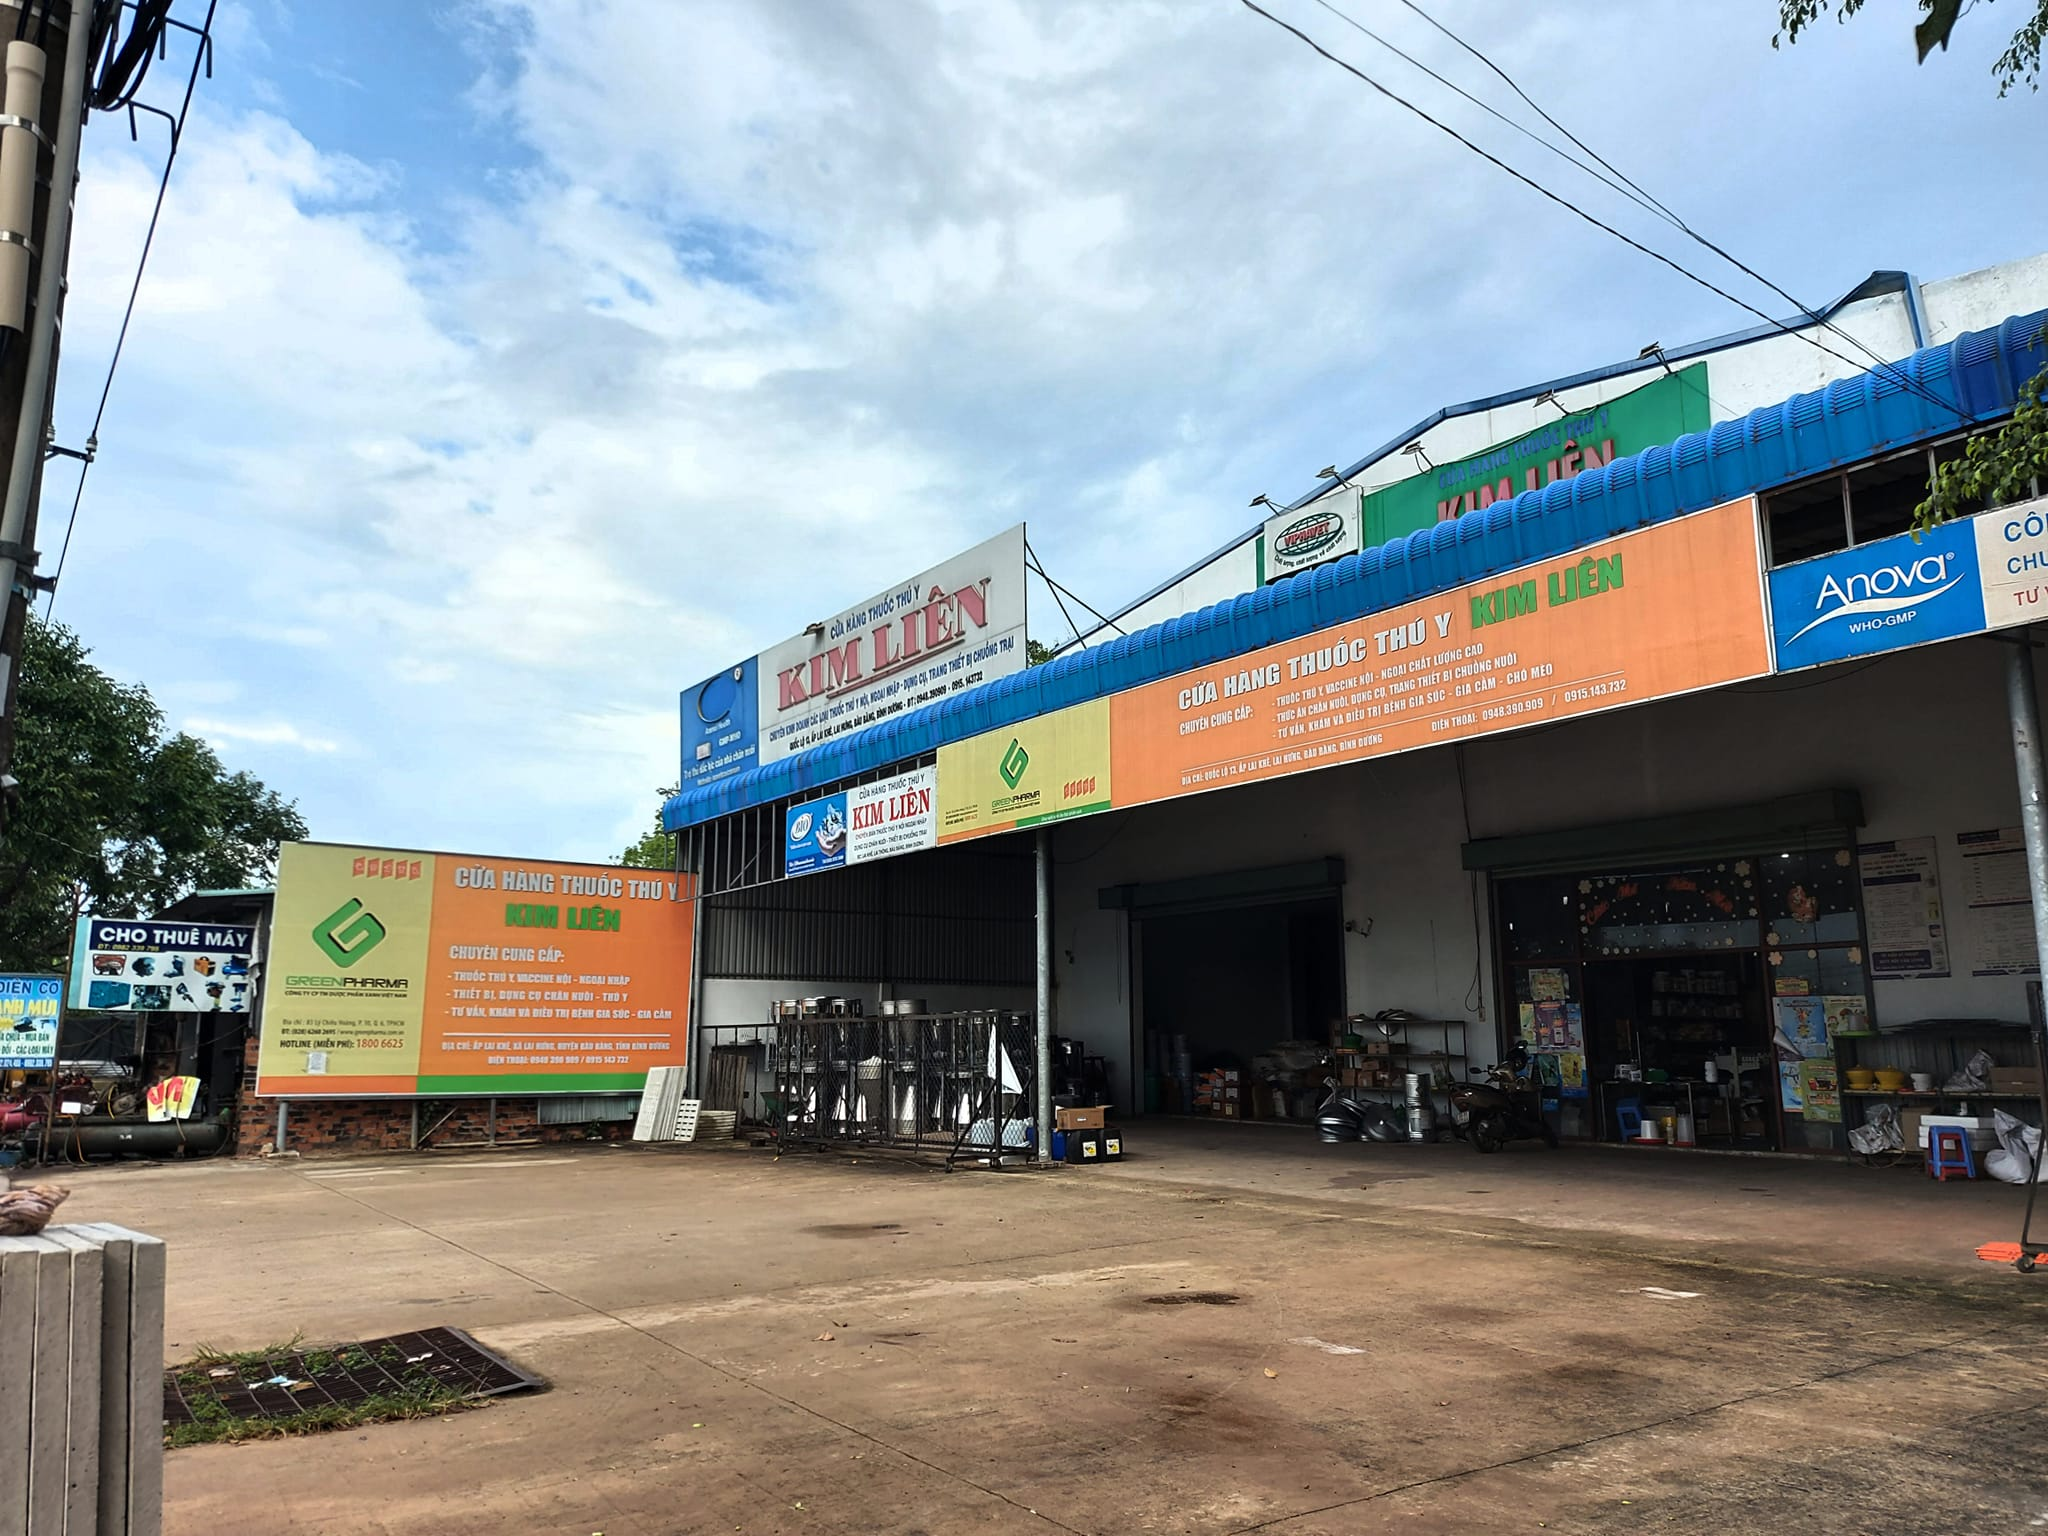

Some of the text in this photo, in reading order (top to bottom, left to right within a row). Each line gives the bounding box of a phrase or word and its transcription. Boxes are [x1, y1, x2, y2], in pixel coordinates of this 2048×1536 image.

[2004, 511, 2048, 542] CÔ
[1815, 553, 1947, 609] Anova
[2014, 586, 2039, 606] TƯ
[830, 585, 920, 640] CỬA HÀNG THUỐC THÚ Y
[1849, 610, 1917, 634] WHO-GMP
[777, 576, 991, 711] KIM LIÊN
[1178, 552, 1624, 710] CỬA HÀNG THUỐC THÚ Y KIM LIÊN
[856, 697, 860, 709] Y
[929, 663, 947, 680] TRANG
[949, 652, 965, 672] THIẾT
[966, 654, 972, 668] BỊ
[999, 635, 1014, 653] TRẠI
[1326, 677, 1358, 694] VACCINE
[1360, 672, 1373, 687] NỘI
[1381, 663, 1406, 680] NGOẠI
[1433, 649, 1462, 667] LƯỢNG
[1465, 643, 1483, 658] CAO
[1389, 678, 1415, 696] TRANG
[1417, 671, 1440, 688] THIẾT
[1443, 671, 1452, 682] BỊ
[1494, 653, 1517, 668] NUÔI
[1333, 713, 1344, 725] VÀ
[1367, 705, 1381, 720] TRỊ
[1384, 700, 1406, 715] BỆNH
[1409, 693, 1424, 708] GIA
[1427, 689, 1446, 704] SÚC
[1456, 684, 1472, 697] GIA
[1475, 676, 1496, 693] CẦM
[1432, 680, 1626, 732] ĐIỆN THOẠI: 0948.390.909 0915.143.732
[1179, 706, 1253, 736] CHUYÊN CUNG CẤP:
[859, 786, 870, 800] CỬA
[871, 782, 886, 796] HÀNG
[888, 778, 907, 792] THUỐC
[920, 774, 925, 782] Y
[992, 790, 1040, 807] GREENPHARMA
[853, 801, 884, 830] KIM
[889, 786, 931, 821] LIÊN
[455, 864, 678, 901] CỬA HÀNG THUỐC THÚ Y
[505, 903, 620, 932] KIM LIÊN
[100, 928, 248, 947] CHO THUÊ MÁY
[450, 945, 564, 963] CHUYÊN CUNG CẤP:
[286, 976, 408, 988] GREENPHARMA
[622, 993, 628, 1001] Y
[596, 1010, 610, 1018] GIA
[637, 1010, 651, 1019] GIA
[280, 1040, 312, 1048] HOTLINE
[357, 1039, 379, 1048] 1800
[381, 1039, 403, 1048] 6625
